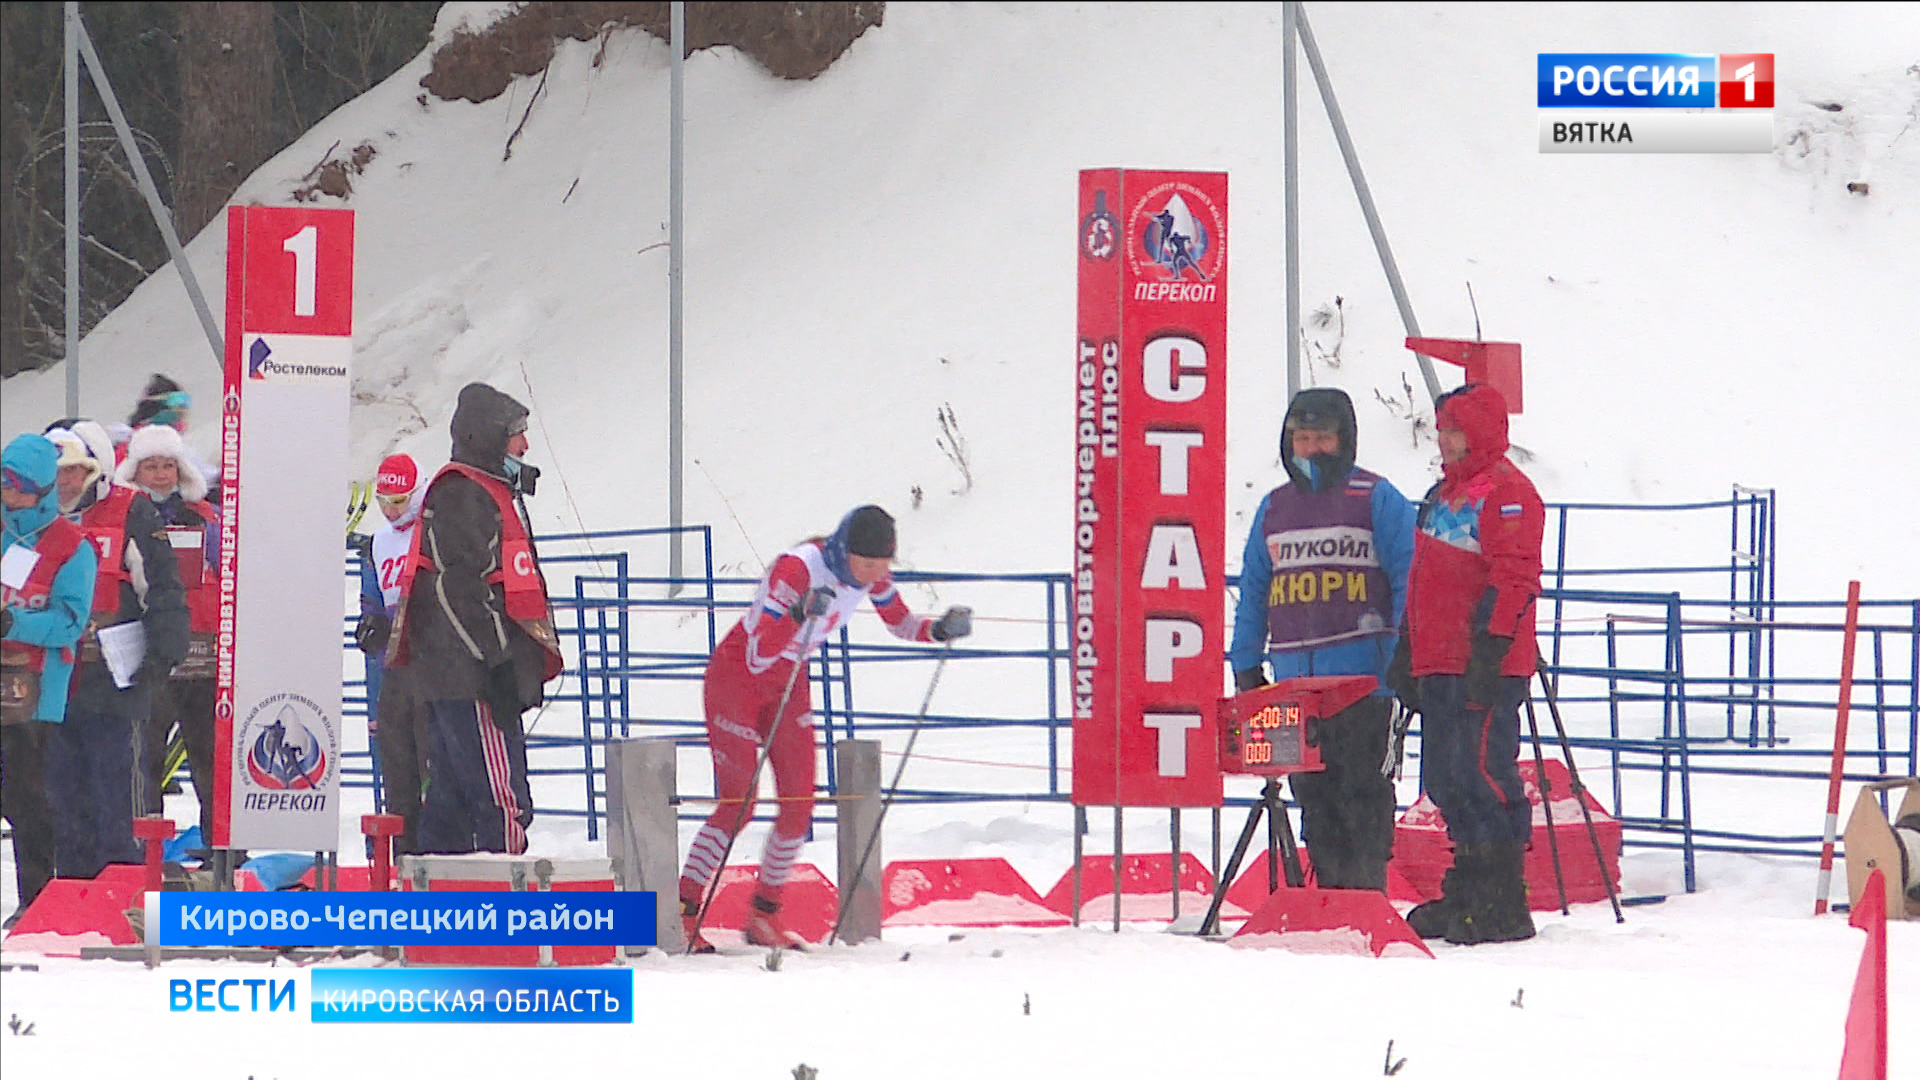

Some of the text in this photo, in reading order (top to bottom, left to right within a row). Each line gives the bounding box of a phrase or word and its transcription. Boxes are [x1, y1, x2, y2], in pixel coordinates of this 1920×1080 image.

[283, 225, 318, 317] 1
[1134, 282, 1217, 302] ПЕРЕКОП
[262, 359, 347, 376] Ростелеком
[1101, 341, 1119, 457] плюс
[217, 414, 239, 688] КИРОВВТОРЧЕРМЕТ ПЛЮС
[1142, 336, 1208, 776] СТАРТ
[1279, 535, 1369, 560] ЛУКОЙЛ
[1269, 570, 1368, 607] ЖЮРИ
[244, 792, 327, 812] ПЕРЕКОП
